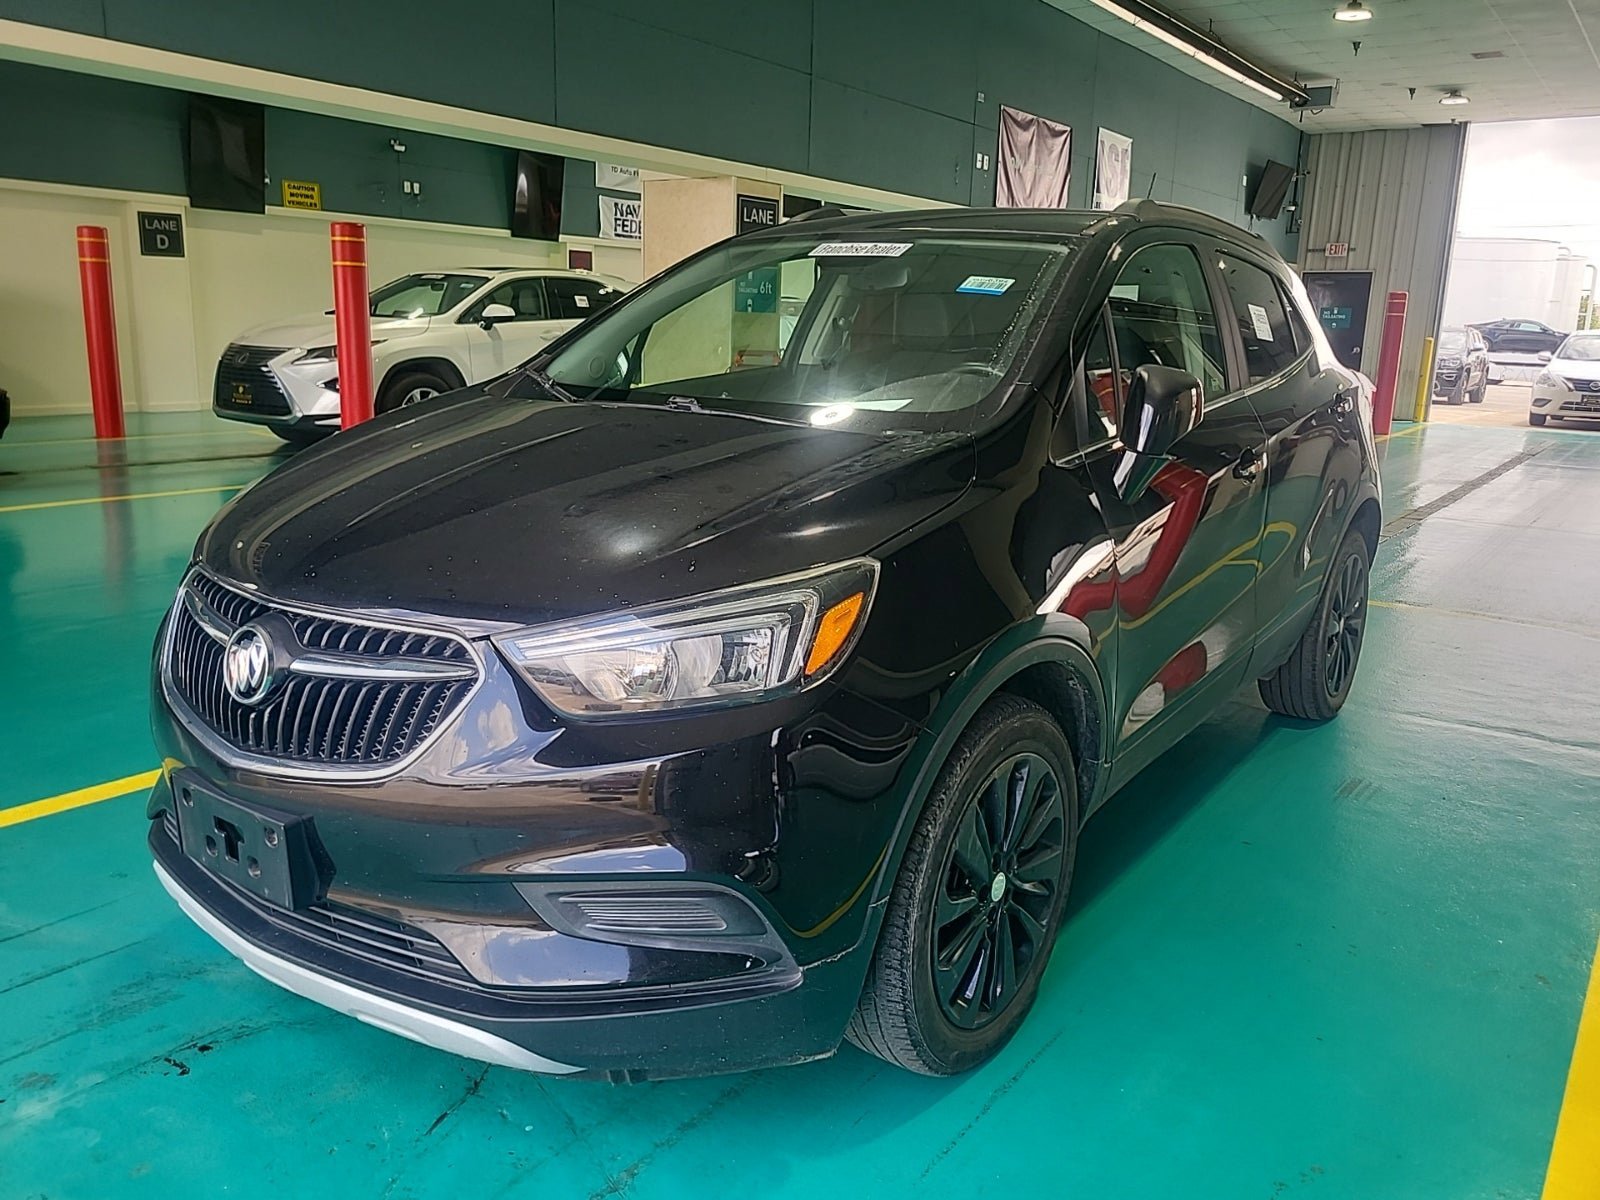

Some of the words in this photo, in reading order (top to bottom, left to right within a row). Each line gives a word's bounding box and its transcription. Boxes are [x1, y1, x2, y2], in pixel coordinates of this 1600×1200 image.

[287, 183, 316, 193] CAUTION
[289, 192, 315, 200] MOVING
[287, 199, 318, 209] VEHICLES
[743, 206, 774, 225] LANE
[145, 218, 178, 232] LANE
[156, 234, 170, 250] D
[820, 243, 869, 255] Franchise
[863, 243, 902, 255] Dealer
[1328, 243, 1345, 256] EXIT
[759, 281, 772, 294] 6ft
